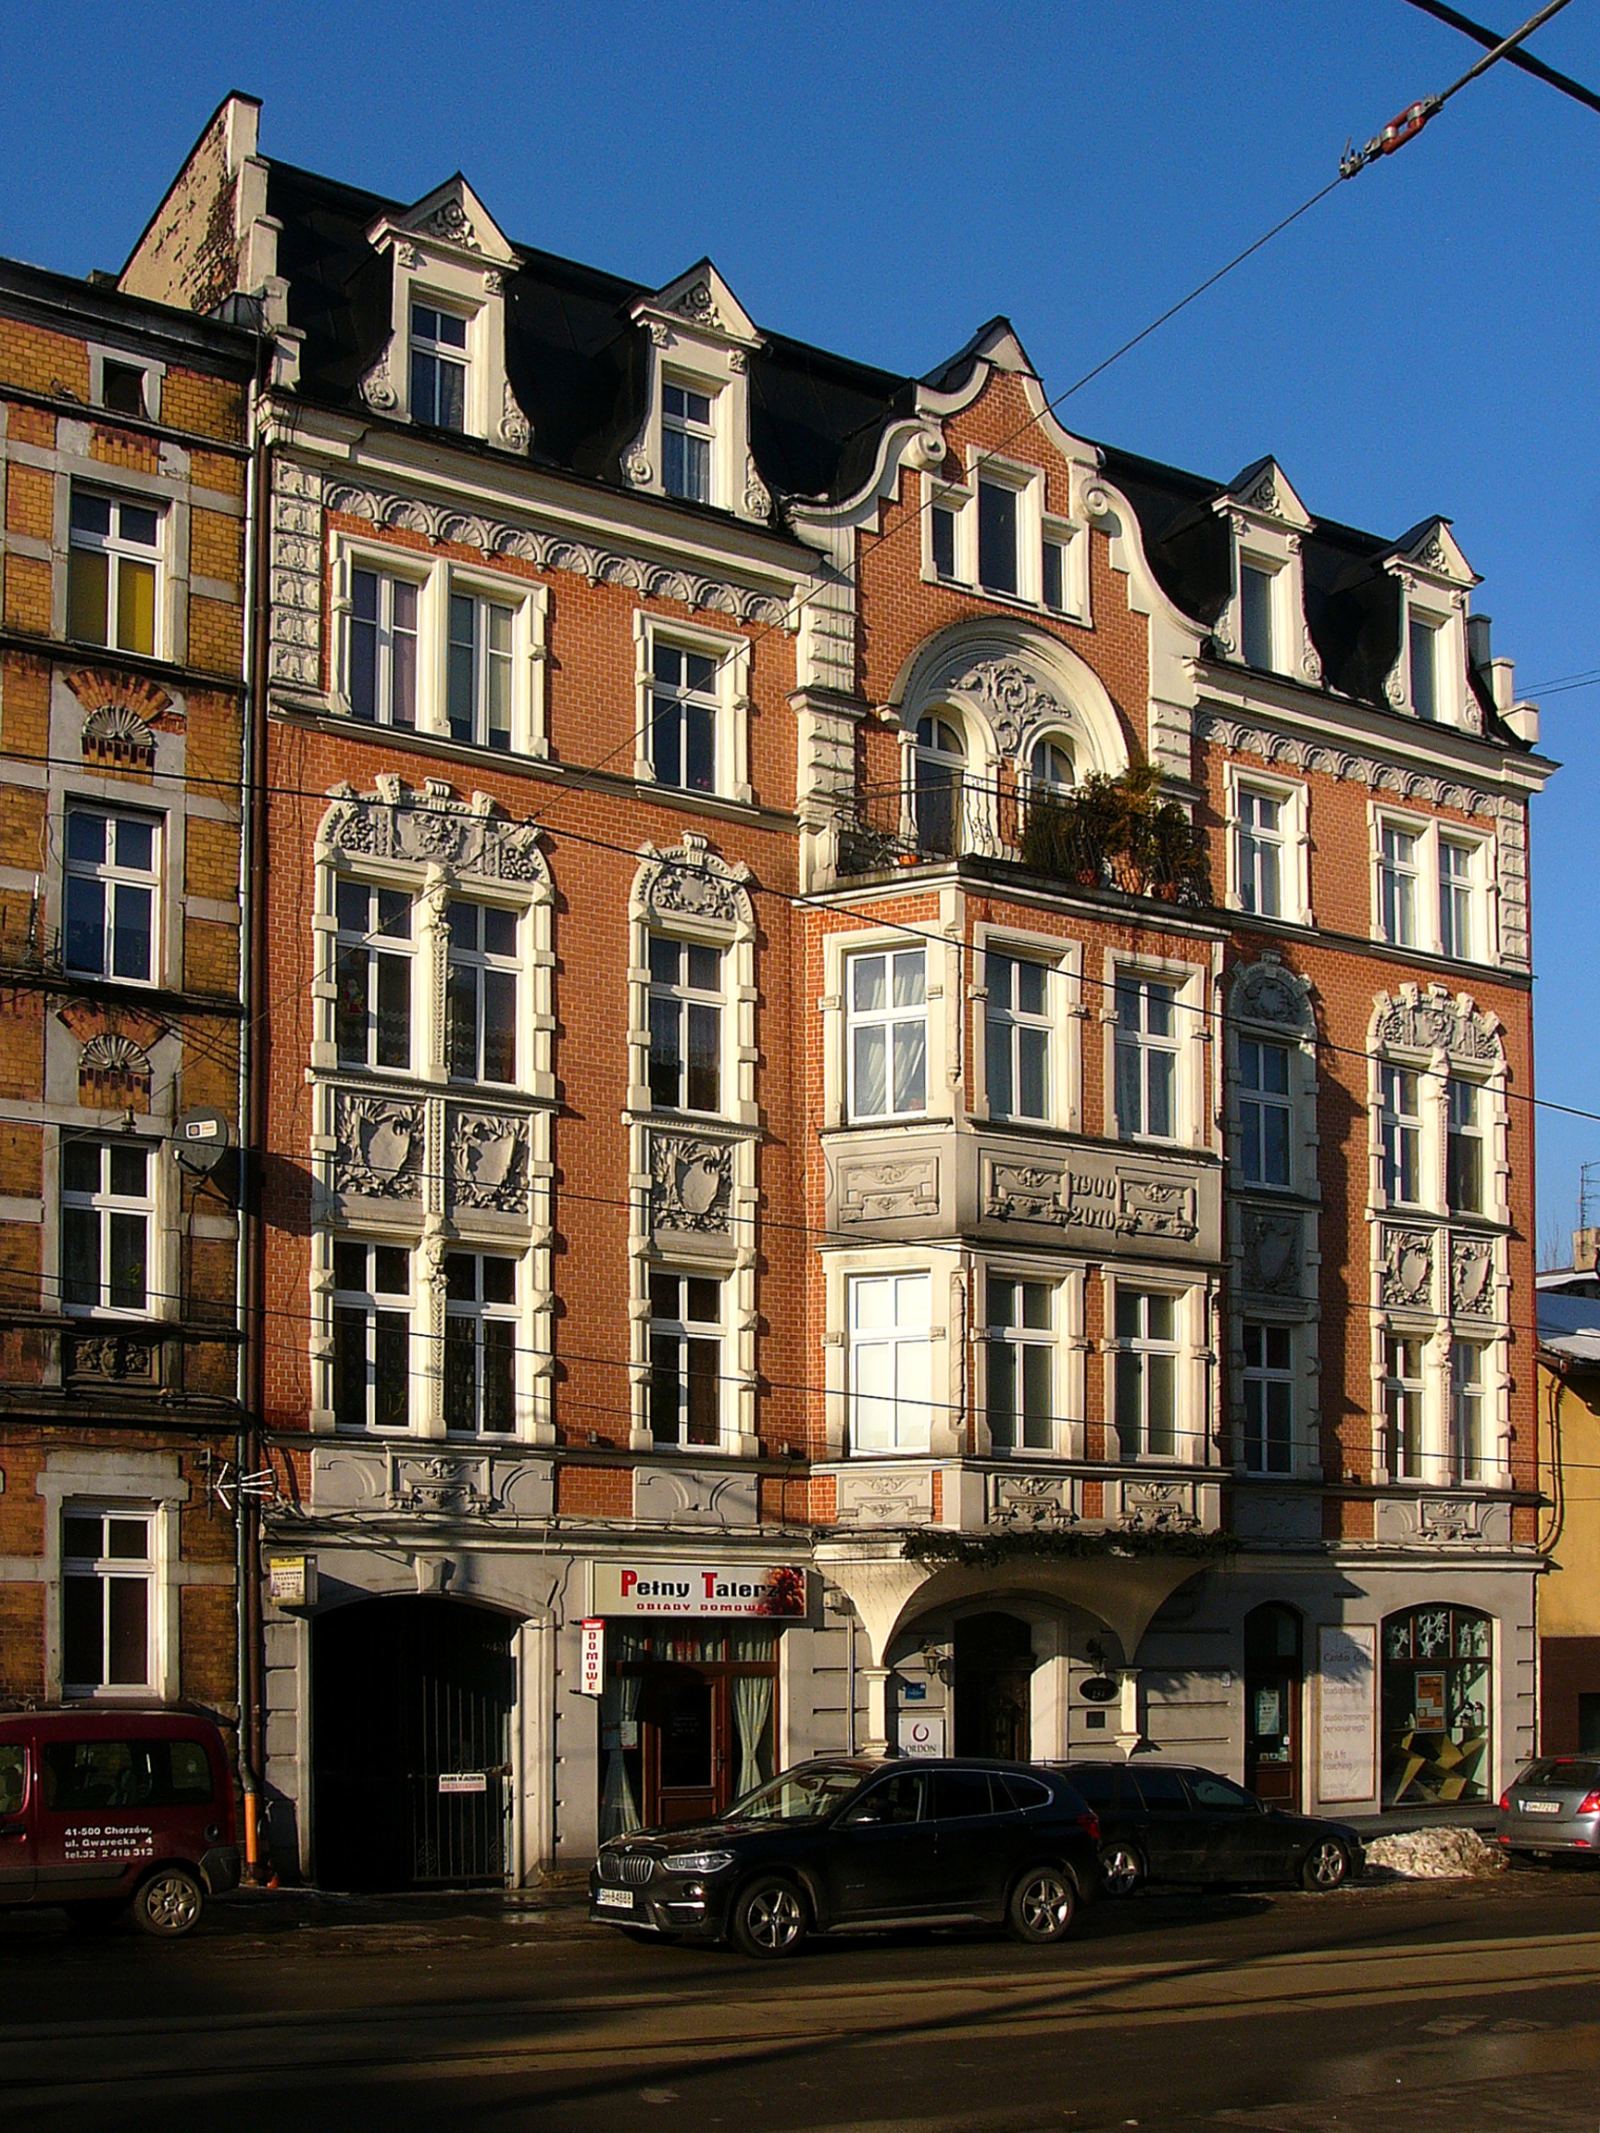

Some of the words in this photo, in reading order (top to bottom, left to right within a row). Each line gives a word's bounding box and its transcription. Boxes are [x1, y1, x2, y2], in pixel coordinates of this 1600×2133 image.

[1072, 1175, 1117, 1200] 1900
[1069, 1205, 1116, 1230] 2010
[621, 1569, 690, 1598] Pełny
[701, 1571, 779, 1599] Talerz
[636, 1603, 691, 1611] OBIADY
[586, 1632, 598, 1690] DOMOWE
[64, 1827, 101, 1836] 41-500
[104, 1825, 153, 1835] Chorzów,
[65, 1839, 79, 1848] ul.
[82, 1837, 136, 1847] Gwarecka
[145, 1836, 153, 1845] 4
[102, 1848, 109, 1858] 2
[111, 1848, 131, 1857] 418
[133, 1847, 154, 1856] 312
